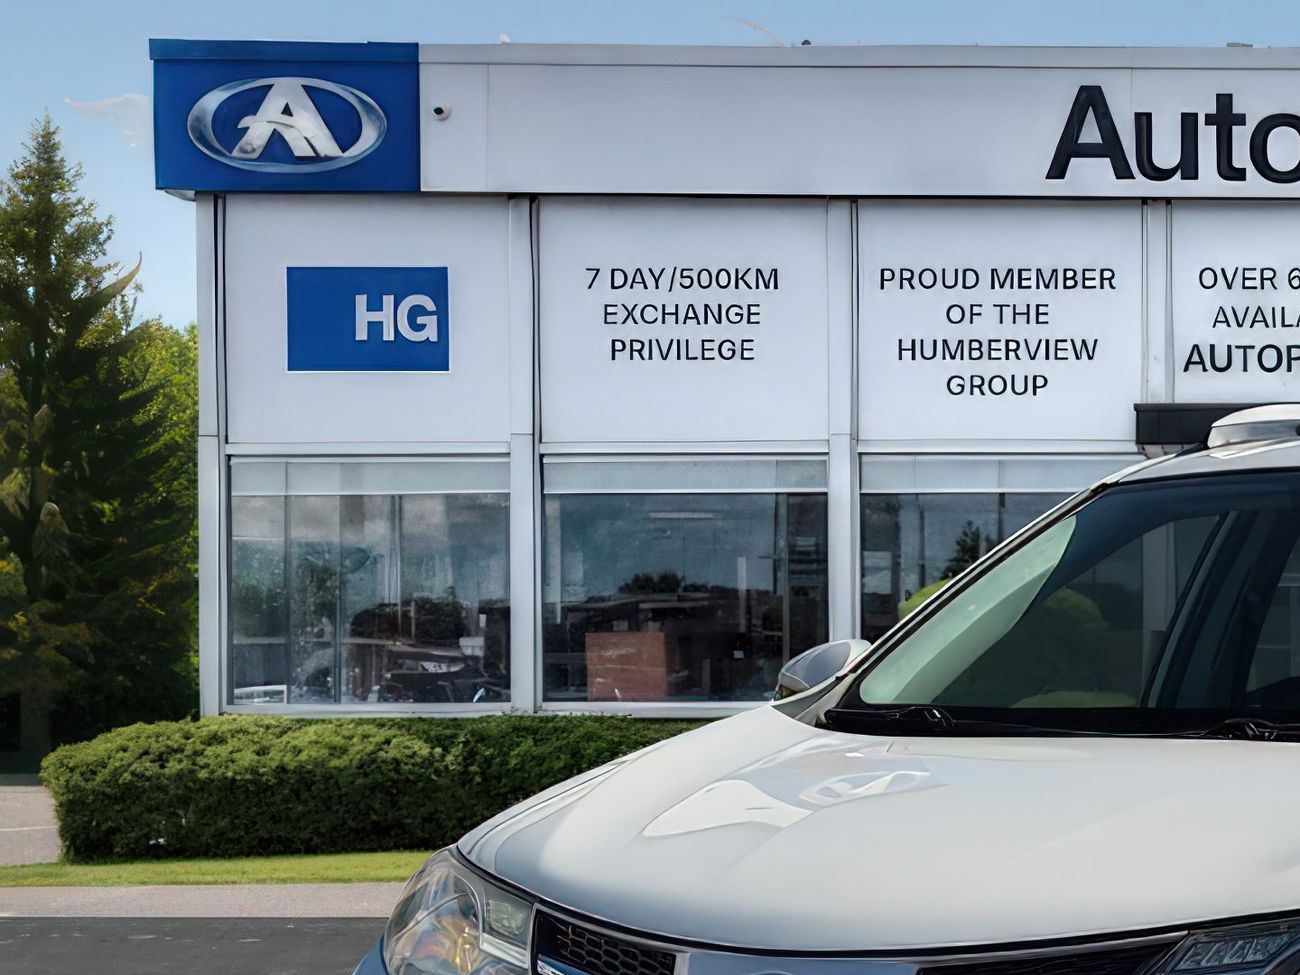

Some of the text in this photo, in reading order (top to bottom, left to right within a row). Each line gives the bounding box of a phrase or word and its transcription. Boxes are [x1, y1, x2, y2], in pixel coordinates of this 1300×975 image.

[585, 266, 779, 293] 7 DAY/500KM
[880, 267, 1116, 291] PROUD MEMBER
[1198, 266, 1278, 291] OVER
[355, 294, 438, 342] HG
[603, 303, 761, 326] EXCHANGE
[945, 303, 1049, 325] OF THE
[611, 338, 755, 361] PRIVILEGE
[898, 338, 1099, 361] HUMBERVIEW
[946, 374, 1049, 397] GROUP
